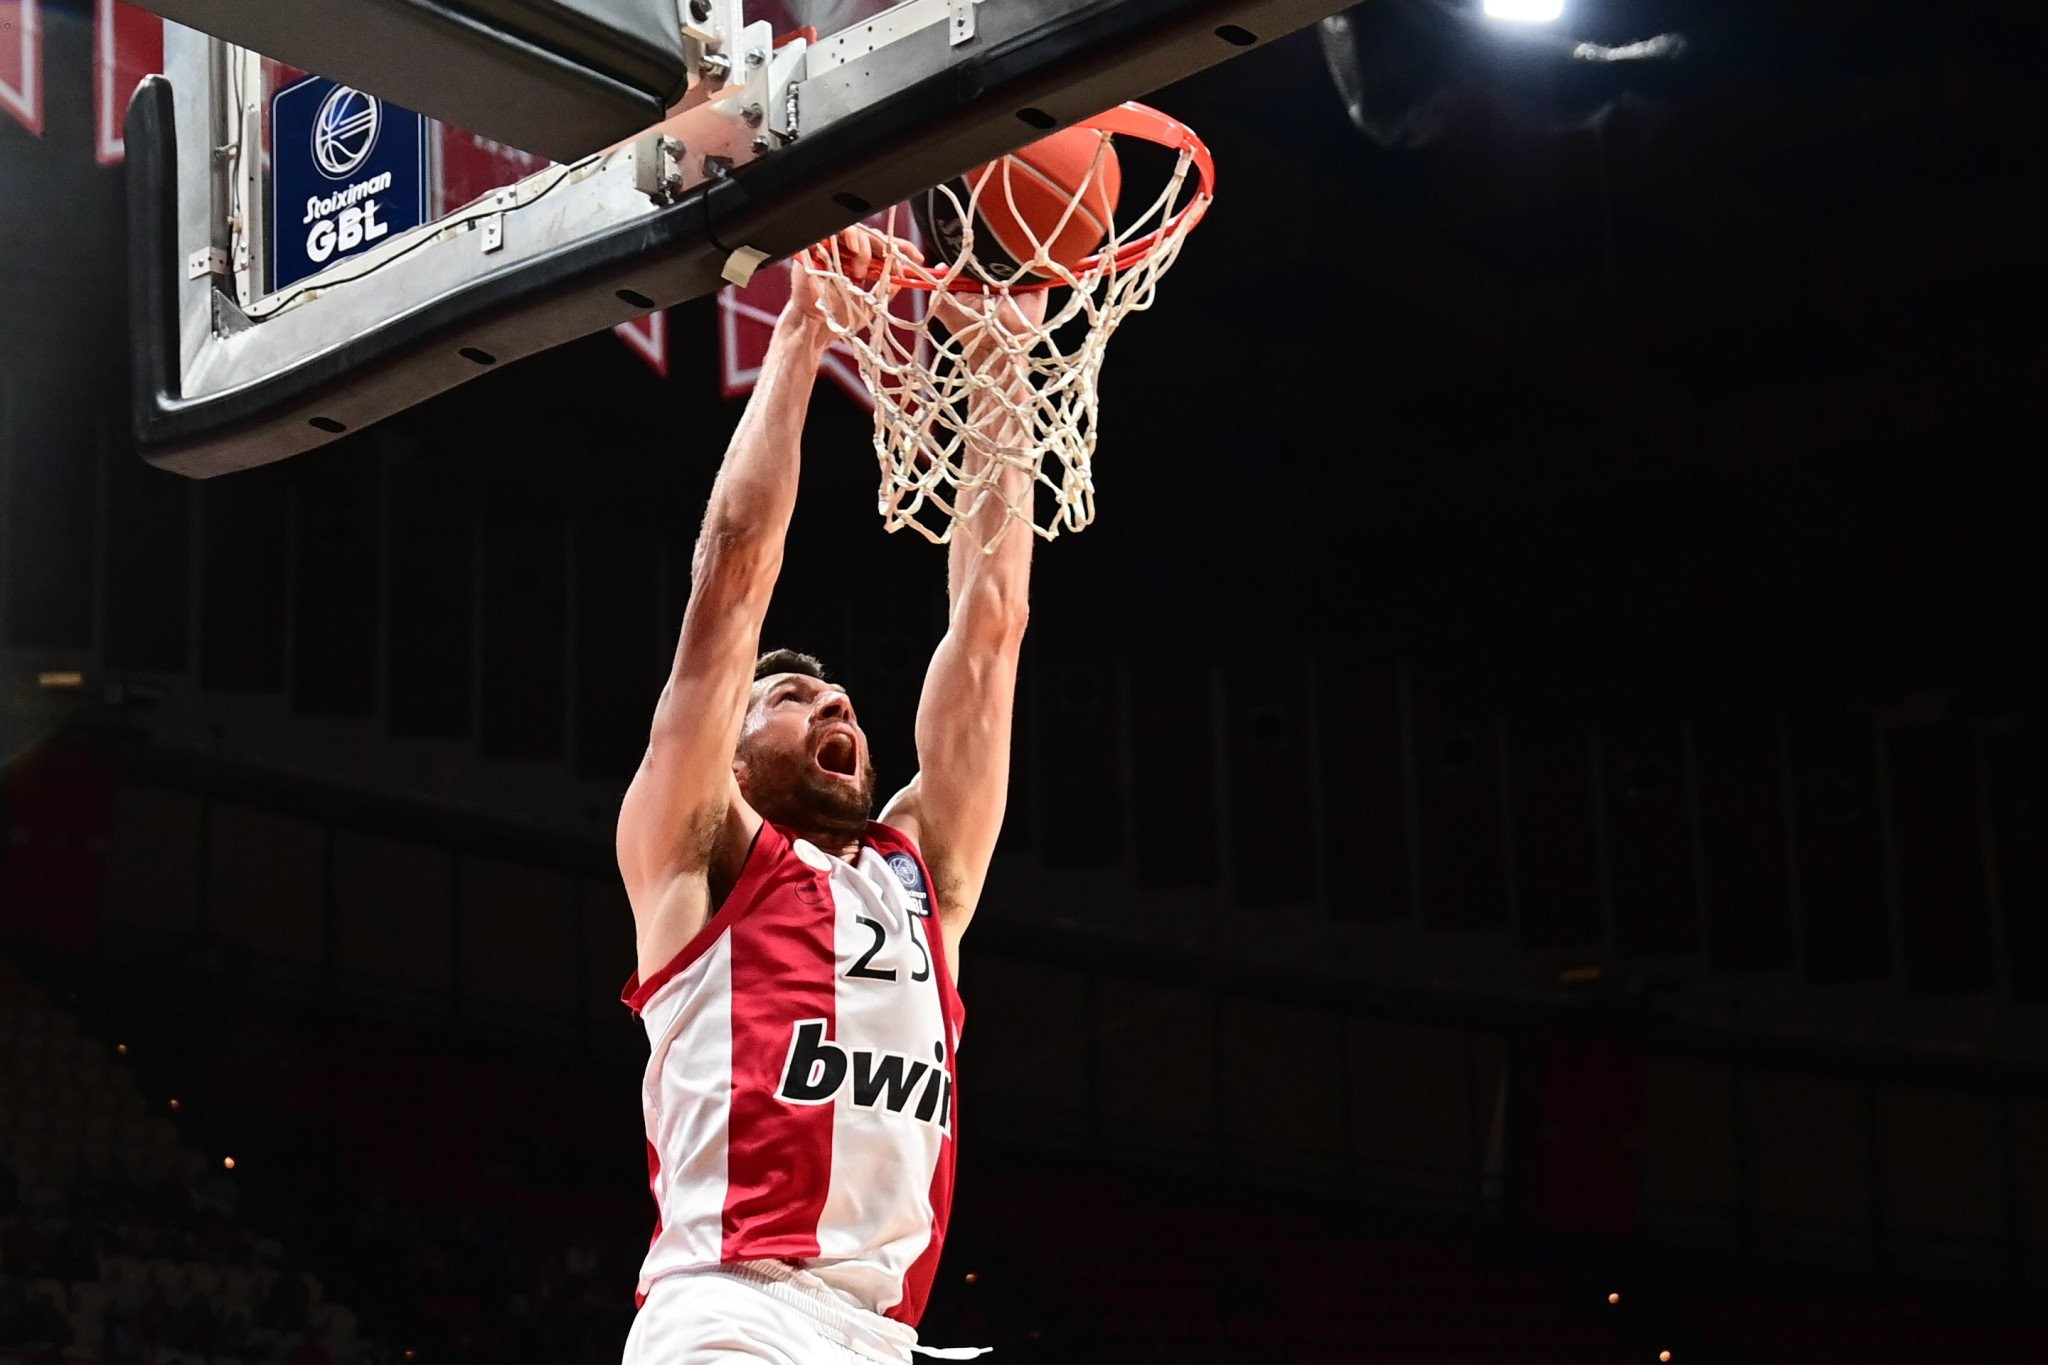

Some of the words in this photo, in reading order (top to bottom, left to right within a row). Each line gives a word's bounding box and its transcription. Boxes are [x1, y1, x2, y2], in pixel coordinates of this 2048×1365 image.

[303, 171, 392, 224] Stoiximan
[306, 199, 388, 263] GBL
[844, 908, 930, 983] 25
